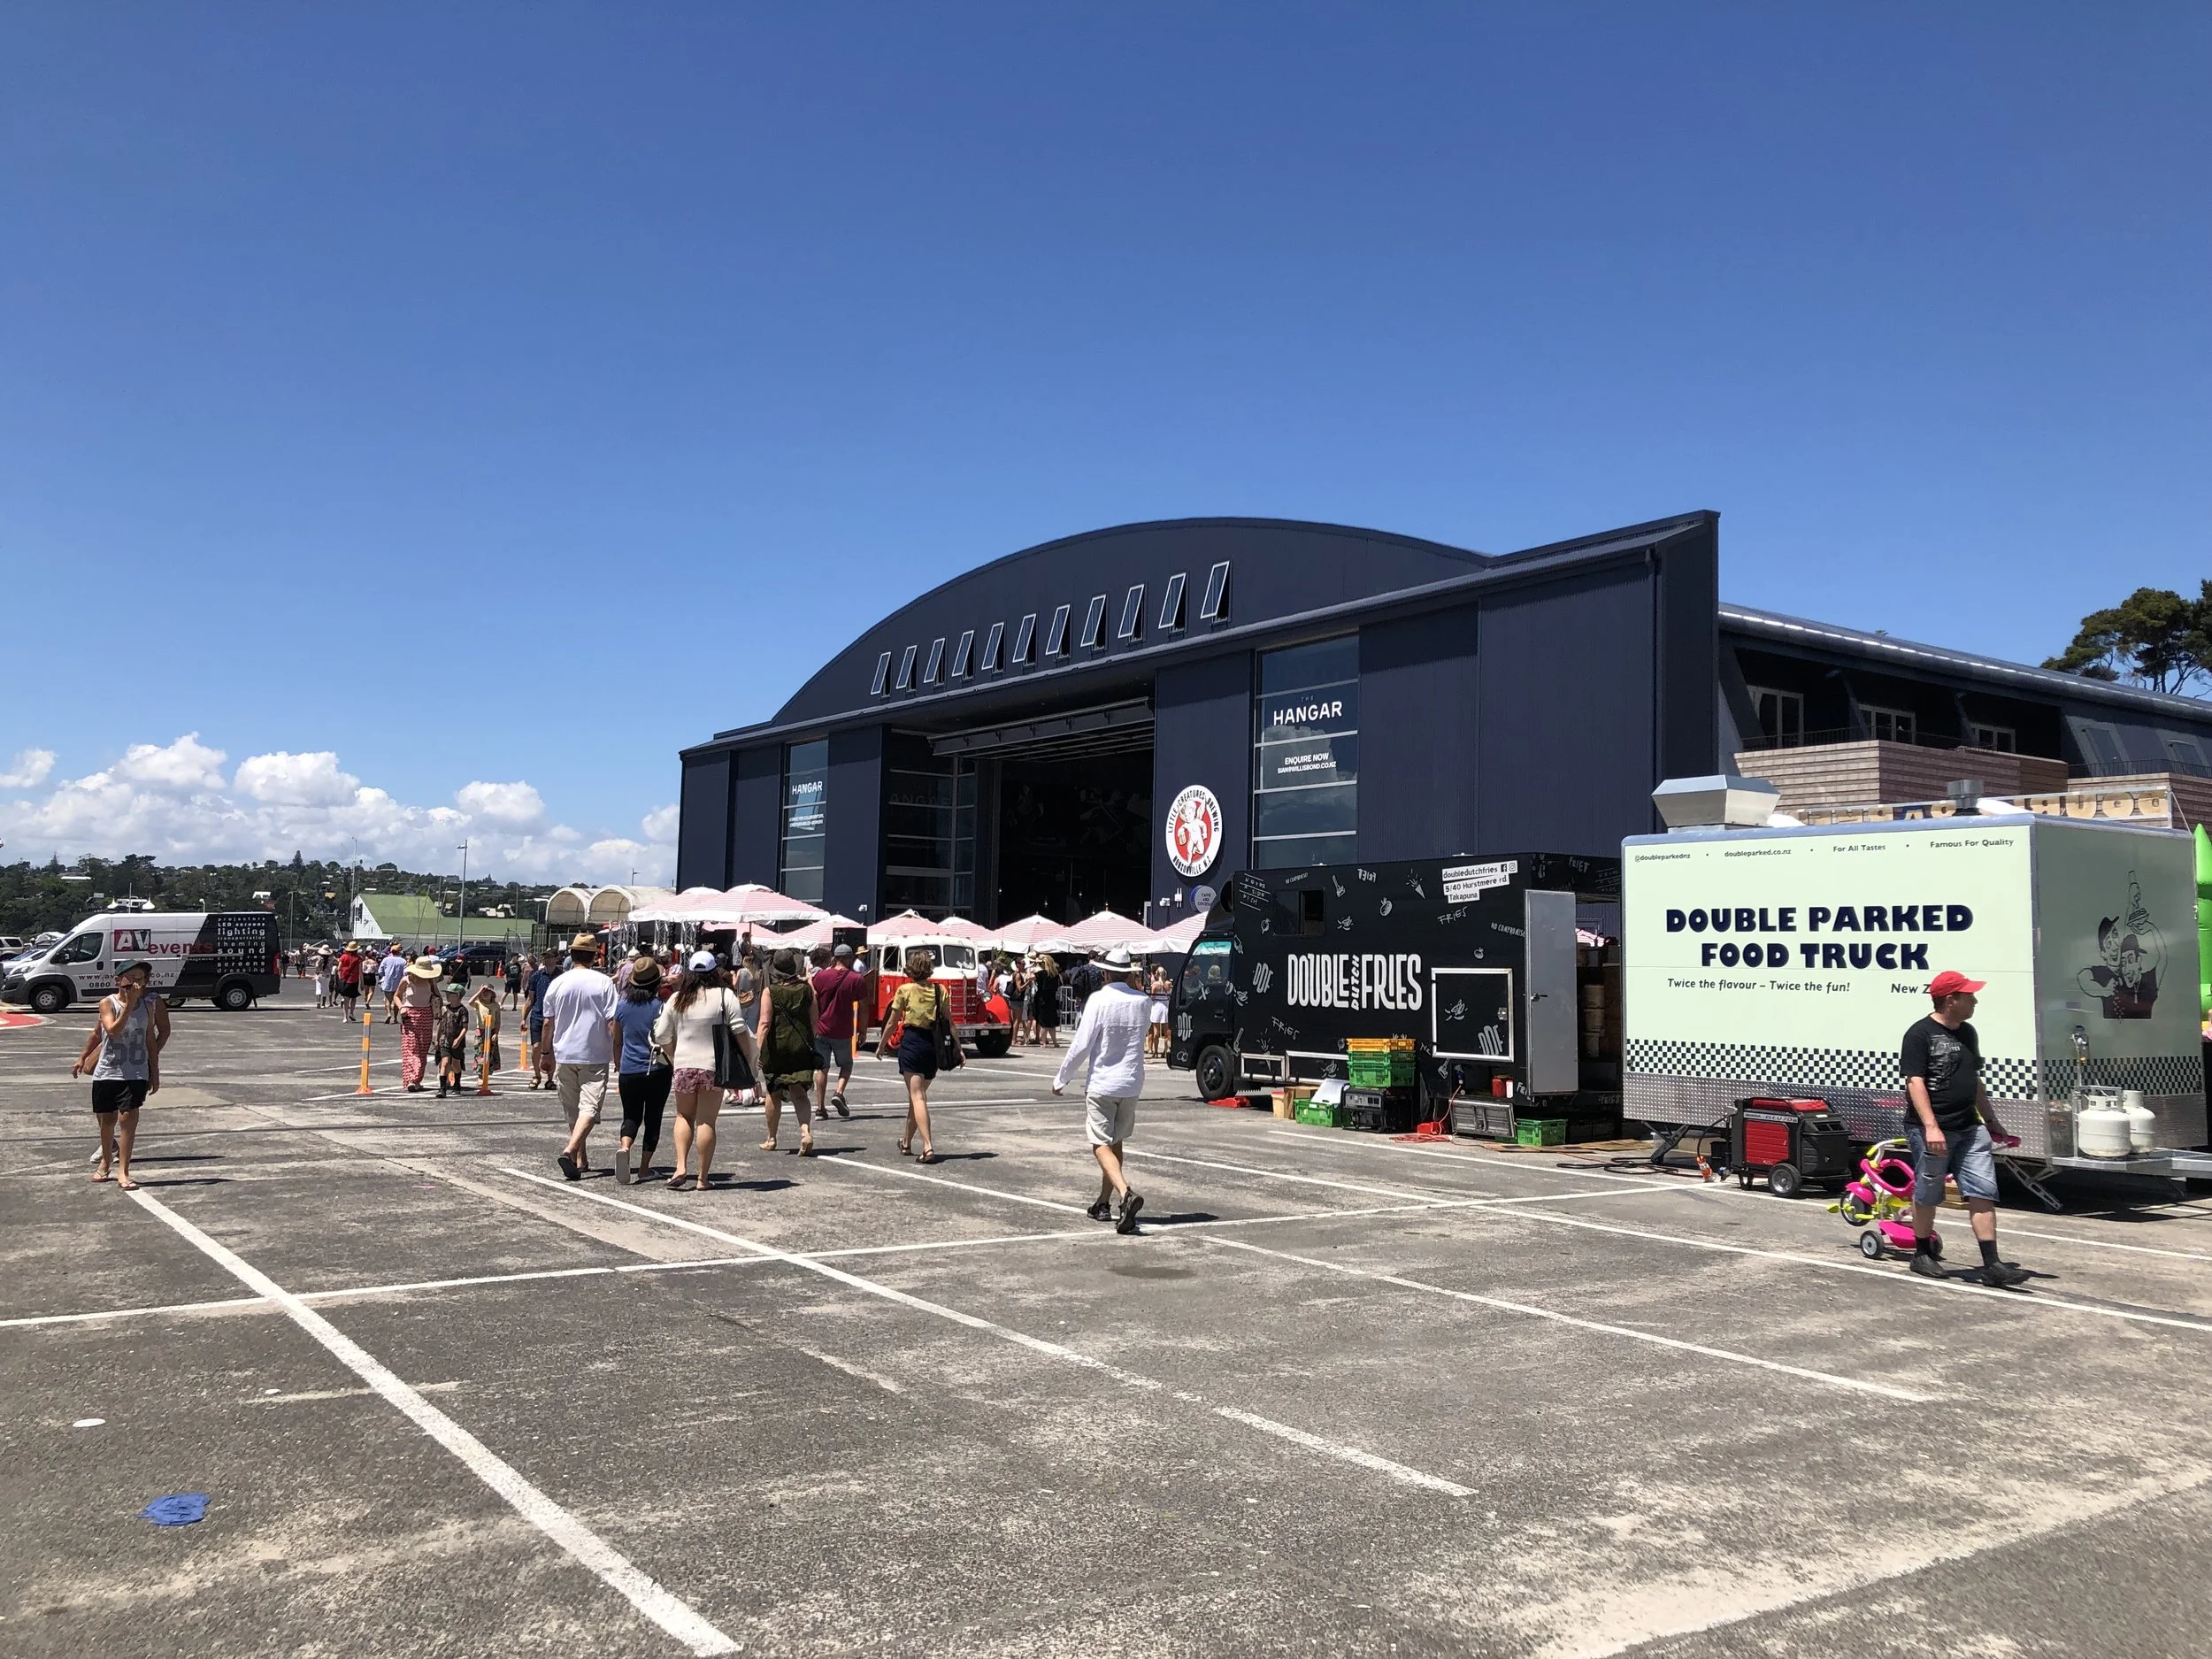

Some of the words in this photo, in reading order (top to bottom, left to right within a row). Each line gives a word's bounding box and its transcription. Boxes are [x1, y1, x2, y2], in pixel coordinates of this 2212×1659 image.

[1274, 701, 1342, 726] HANGAR
[1285, 755, 1311, 765] ENQUIRE
[1313, 752, 1329, 761] NOW
[792, 780, 823, 795] HANGAR
[1168, 807, 1178, 833] LITTLE
[1178, 789, 1206, 808] CREATURES
[1206, 797, 1219, 833] BREWING
[1982, 838, 2014, 847] Quality
[1635, 853, 1691, 862] @doubleparkednz
[1724, 849, 1792, 857] doubleparked.co.nz
[1443, 866, 1498, 879] doubledutchfries
[1445, 883, 1462, 893] 5/40
[1463, 877, 1497, 889] Hurstmere
[1449, 892, 1479, 902] Takapuna
[1437, 906, 1469, 926] FRIES
[1666, 907, 1797, 933] DOUBLE
[1809, 904, 1974, 932] PARKED
[218, 927, 265, 936] lighting
[1701, 942, 1790, 968] FOOD
[1800, 942, 1930, 970] TRUCK
[1287, 953, 1349, 1008] DOUBLE
[1350, 954, 1360, 1011] DUTCH
[1361, 954, 1423, 1010] FRIES
[1667, 978, 1696, 988] Twice
[1699, 979, 1716, 988] the
[1718, 979, 1756, 991] flavour
[1770, 980, 1801, 991] Twice
[1804, 981, 1823, 991] the
[1826, 982, 1851, 994] fun!
[1891, 983, 1918, 994] New
[1271, 1016, 1301, 1041] FRIES
